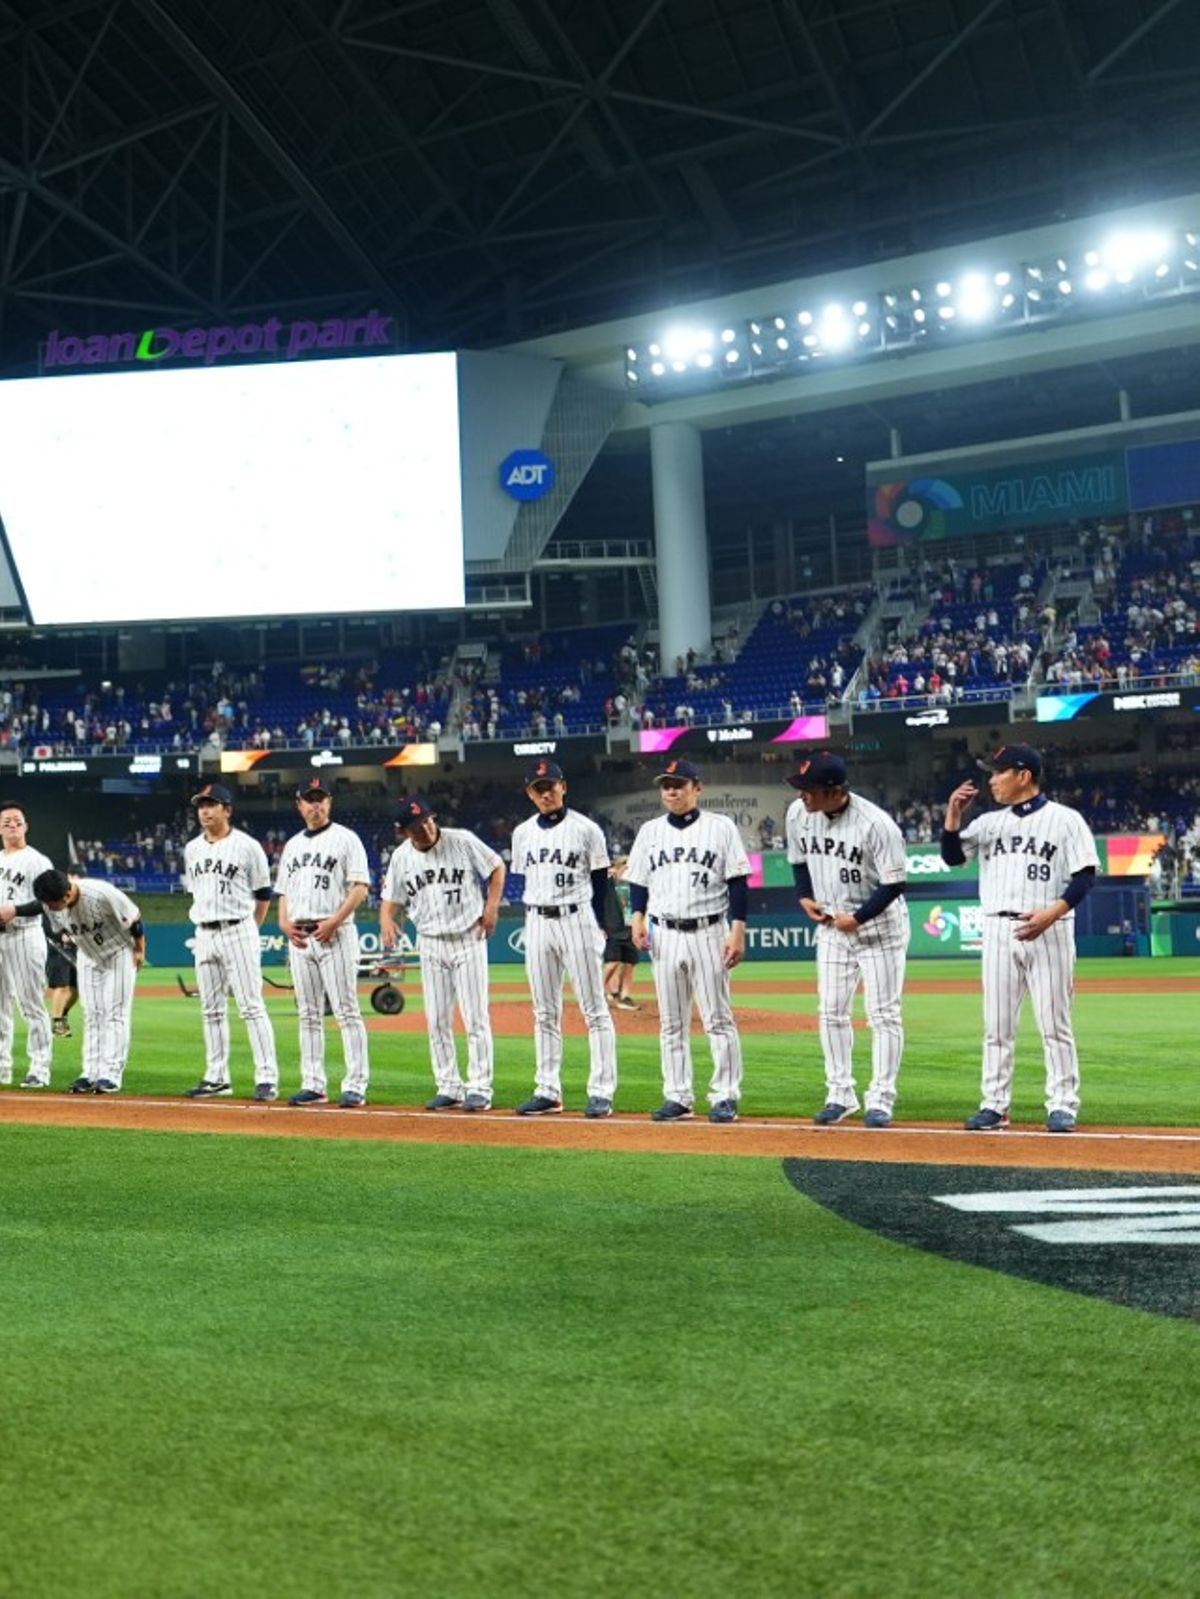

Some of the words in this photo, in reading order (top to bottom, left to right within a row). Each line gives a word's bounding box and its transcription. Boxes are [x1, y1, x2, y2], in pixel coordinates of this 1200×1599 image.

[45, 317, 282, 367] loanDepot
[286, 309, 393, 358] park
[507, 464, 548, 486] ADT
[971, 465, 1115, 521] MIAMI
[514, 742, 557, 756] DIRECTV
[525, 848, 580, 869] APAN
[650, 847, 717, 872] JAPAN
[800, 836, 864, 866] JAPAN
[287, 852, 338, 878] JAPAN
[1026, 864, 1051, 882] 89
[314, 875, 331, 890] 79
[406, 867, 466, 897] JAPAN
[555, 873, 575, 888] 84
[691, 872, 709, 888] 74
[839, 868, 862, 884] 88
[6, 886, 15, 900] 2
[444, 889, 462, 905] 77
